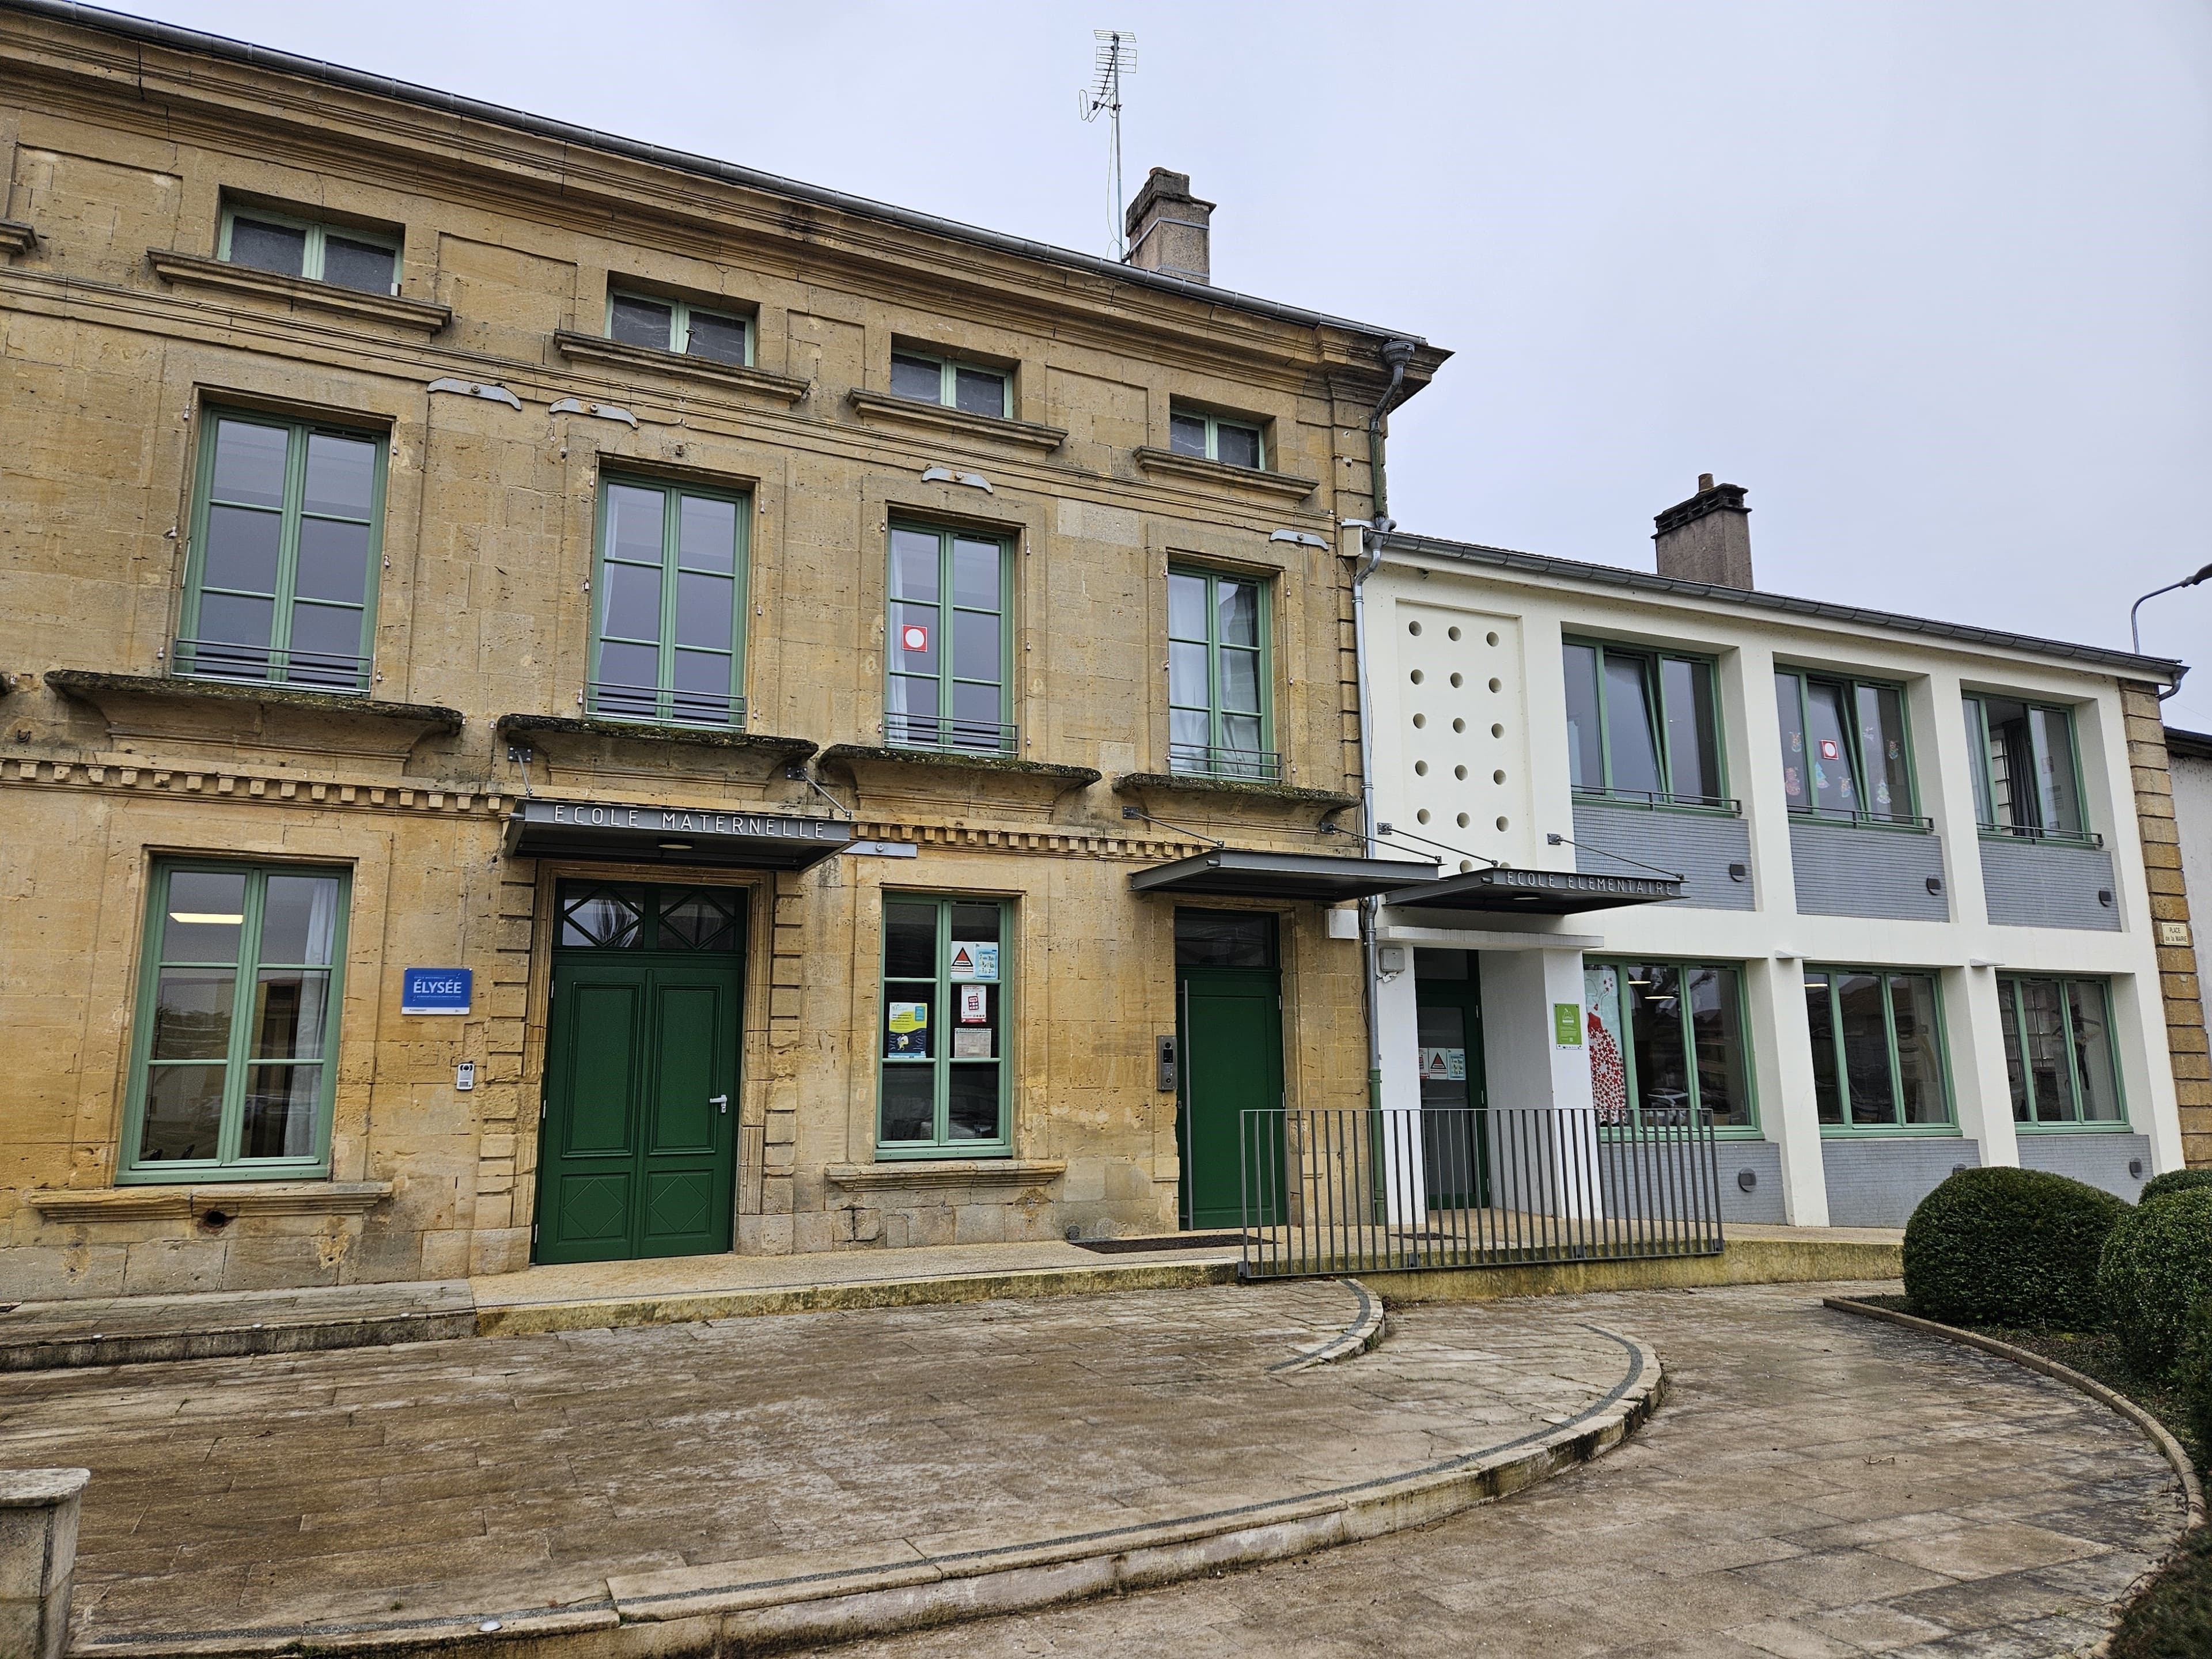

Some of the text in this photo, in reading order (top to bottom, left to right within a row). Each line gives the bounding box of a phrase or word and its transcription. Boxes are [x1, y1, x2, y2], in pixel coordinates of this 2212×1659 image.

[554, 805, 824, 838] ECOLE MATERNELLE
[1507, 871, 1673, 895] ECOLE ELEMENTAIRE
[413, 979, 463, 993] ÉLYSÉE
